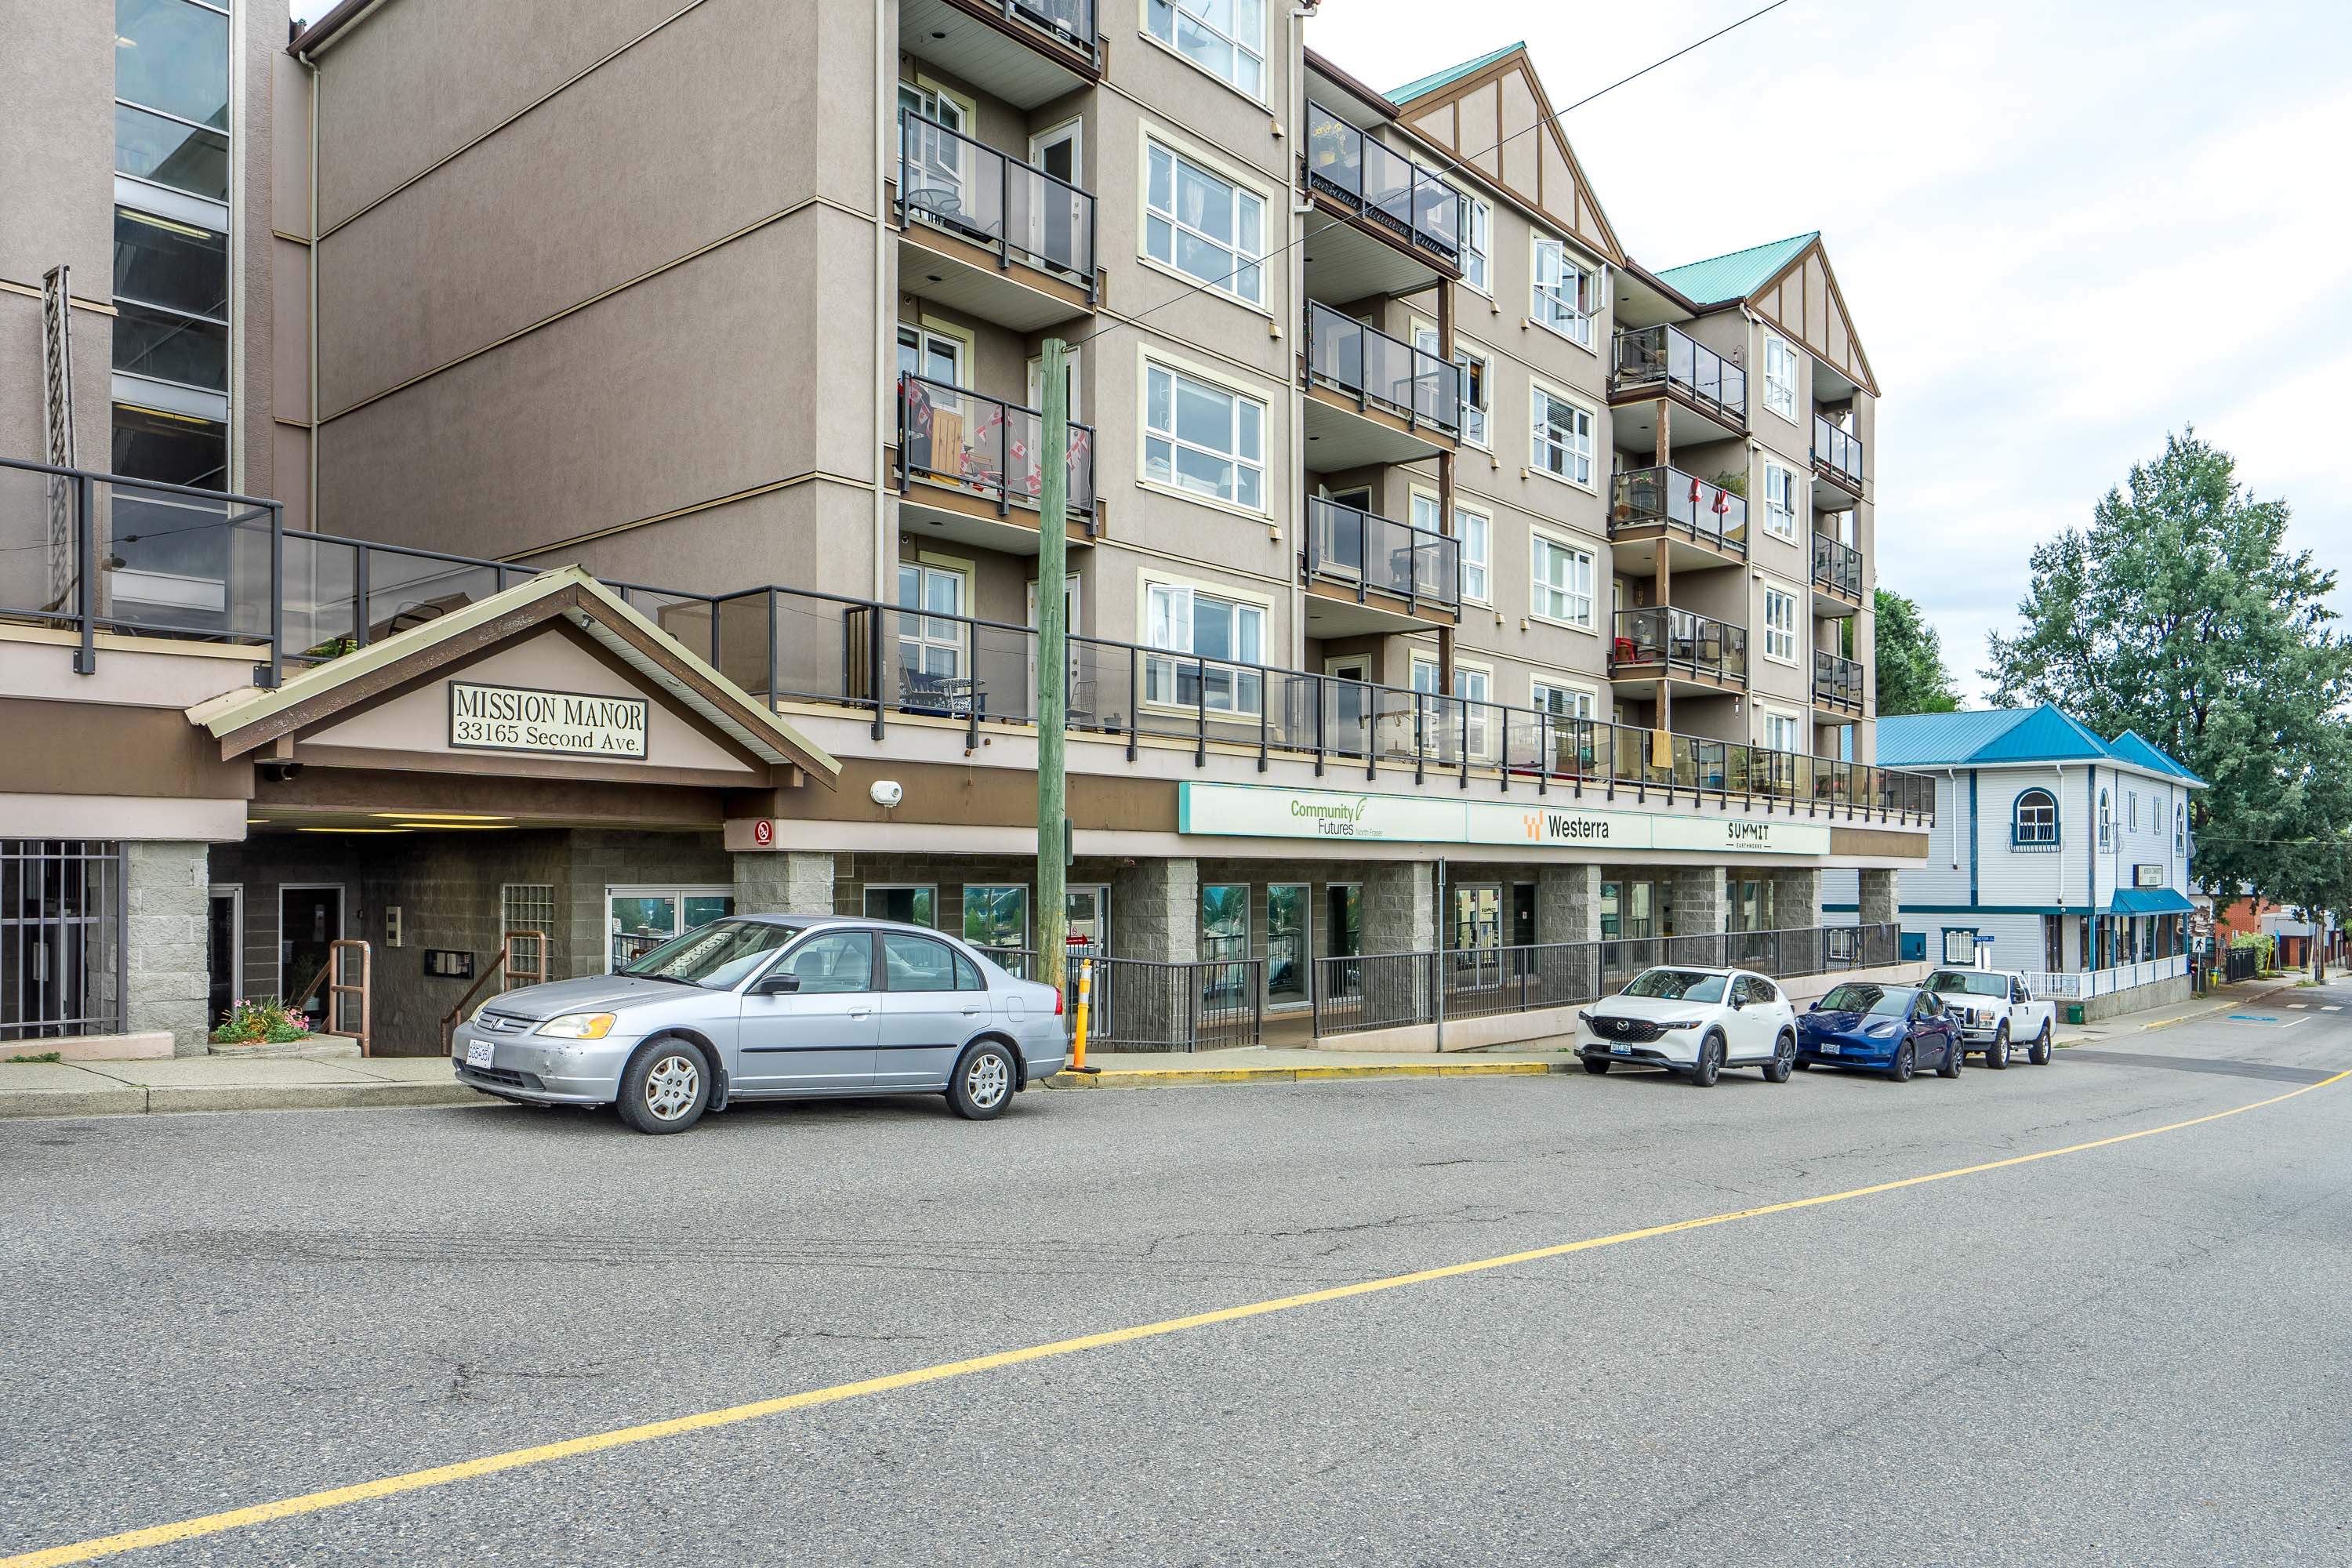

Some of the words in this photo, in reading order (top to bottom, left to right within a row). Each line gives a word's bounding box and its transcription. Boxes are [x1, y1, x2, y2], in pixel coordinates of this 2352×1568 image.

[456, 689, 557, 723] MISSION
[564, 699, 643, 731] MANOR
[457, 720, 520, 743] 33165
[526, 726, 593, 748] Second
[601, 732, 640, 752] Ave.
[1291, 800, 1353, 822] Community
[1319, 818, 1354, 836] Futures
[1548, 815, 1610, 839] Westerra
[1728, 822, 1769, 840] SUMMIT
